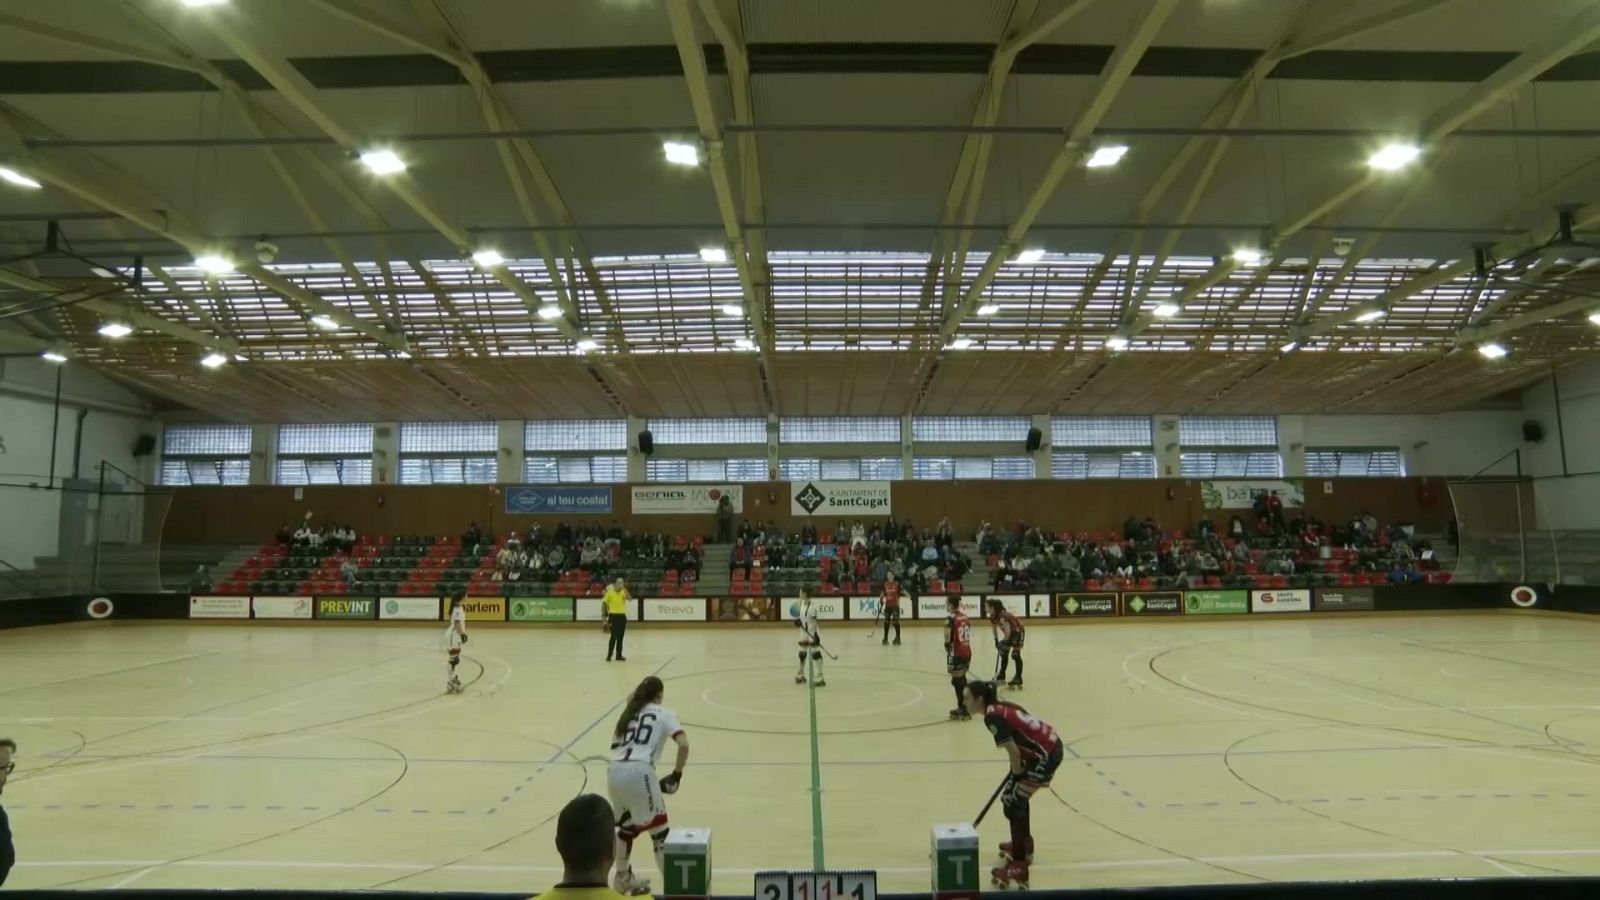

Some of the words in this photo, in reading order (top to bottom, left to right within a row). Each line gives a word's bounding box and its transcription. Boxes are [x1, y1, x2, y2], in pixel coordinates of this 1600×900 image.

[829, 497, 887, 508] SantCugat
[320, 600, 371, 613] PREVINT
[674, 860, 696, 889] T
[948, 855, 970, 885] T
